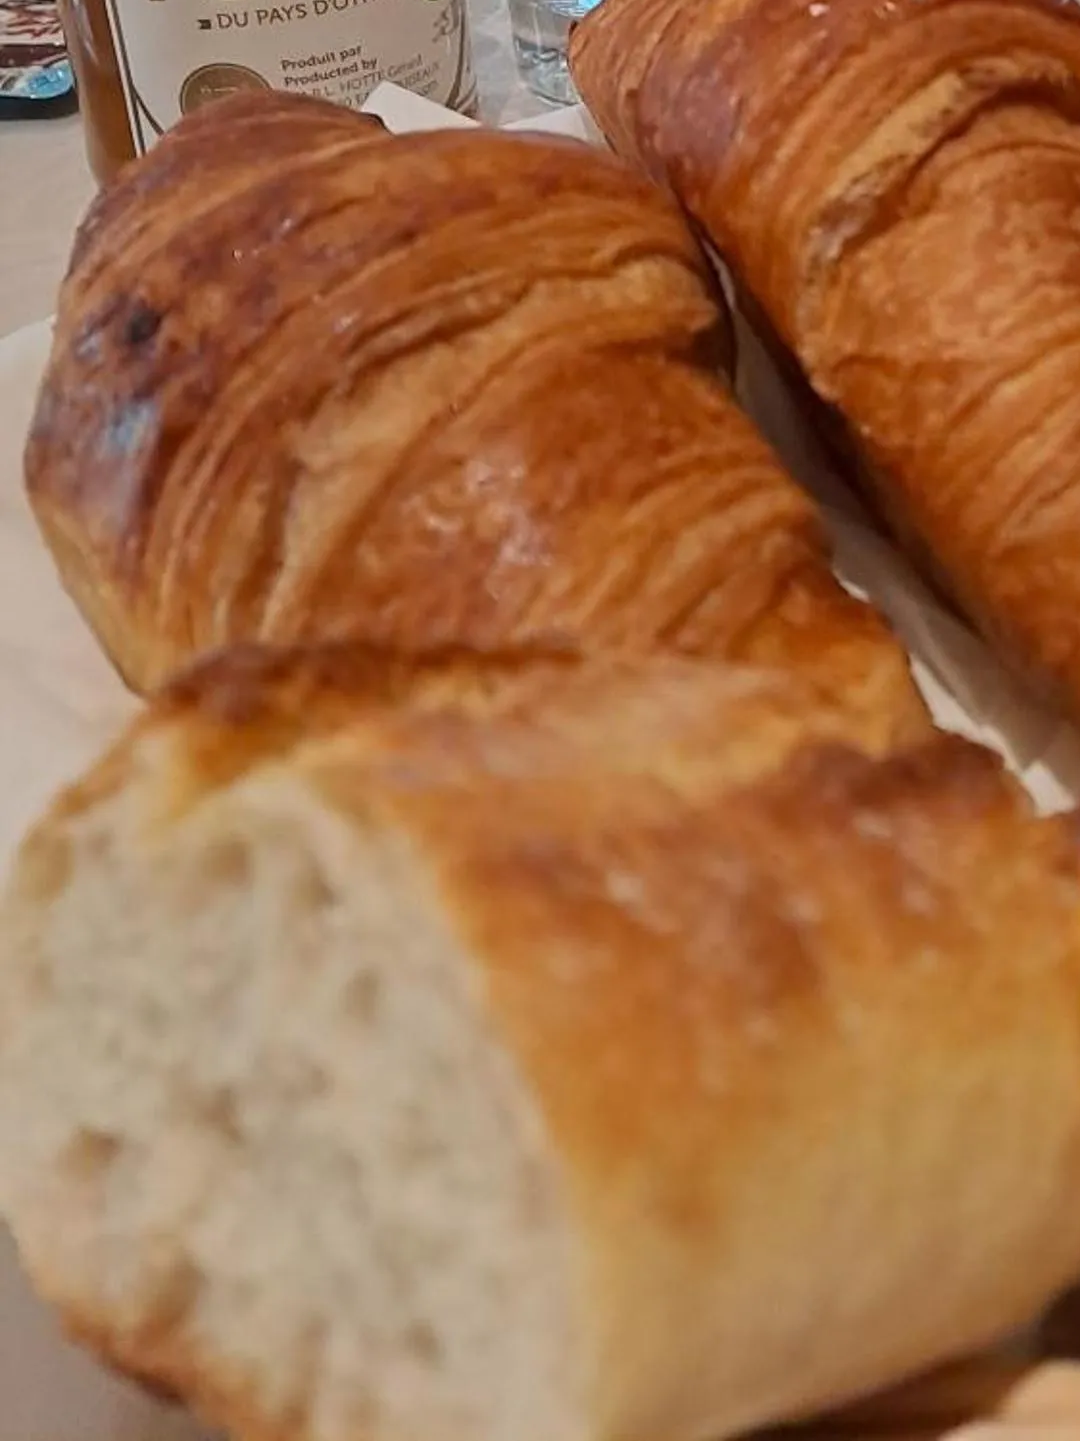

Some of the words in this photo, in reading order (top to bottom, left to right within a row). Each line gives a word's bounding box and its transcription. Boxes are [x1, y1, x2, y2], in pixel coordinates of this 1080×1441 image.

[216, 13, 249, 30] DU
[256, 1, 308, 27] PAYS
[362, 58, 378, 71] by
